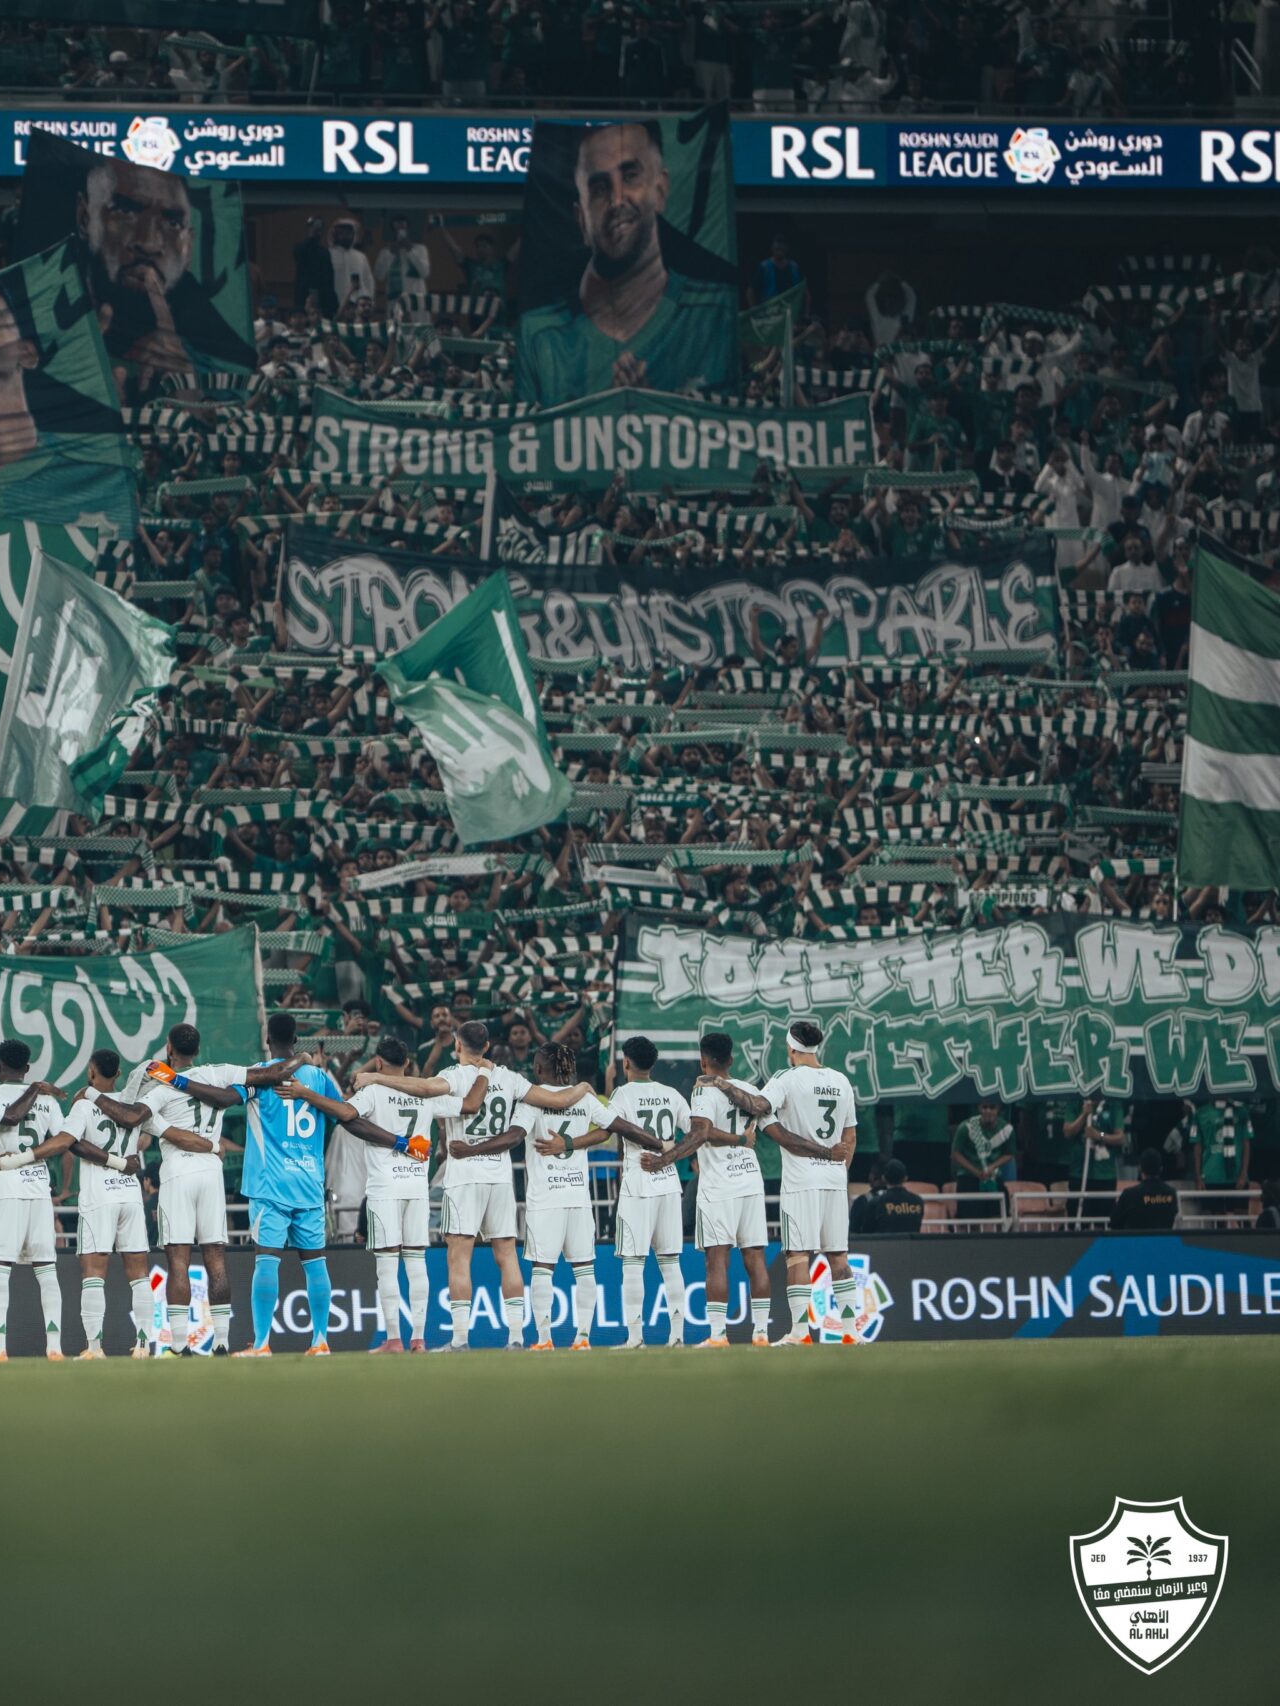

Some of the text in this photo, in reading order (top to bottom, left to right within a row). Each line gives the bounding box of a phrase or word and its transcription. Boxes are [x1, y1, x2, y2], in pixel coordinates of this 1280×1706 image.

[70, 120, 117, 136] SAUDI
[184, 120, 284, 143] دوري روشن
[467, 128, 520, 143] ROSHN
[899, 132, 999, 149] ROSHN SAUDI
[1064, 130, 1162, 153] دوري روشن
[184, 146, 284, 175] السعودي
[322, 120, 428, 175] RSL
[770, 126, 875, 179] RSL
[899, 152, 998, 178] LEAGUE
[1064, 155, 1162, 185] السعودي
[313, 413, 867, 475] STRONG & UNSTOPPABLE
[1076, 921, 1190, 1004] WE
[1143, 1007, 1257, 1098] WE
[813, 1085, 841, 1097] IBAÑEZ
[19, 1113, 39, 1152] 5
[283, 1099, 317, 1138] 16
[398, 1109, 418, 1138] 7
[466, 1096, 507, 1136] 28
[637, 1108, 675, 1142] 30
[816, 1099, 837, 1139] 3
[554, 1120, 574, 1160] 6
[886, 1202, 921, 1215] Police
[912, 1276, 1074, 1321] ROSHN
[1090, 1274, 1225, 1316] SAUDI
